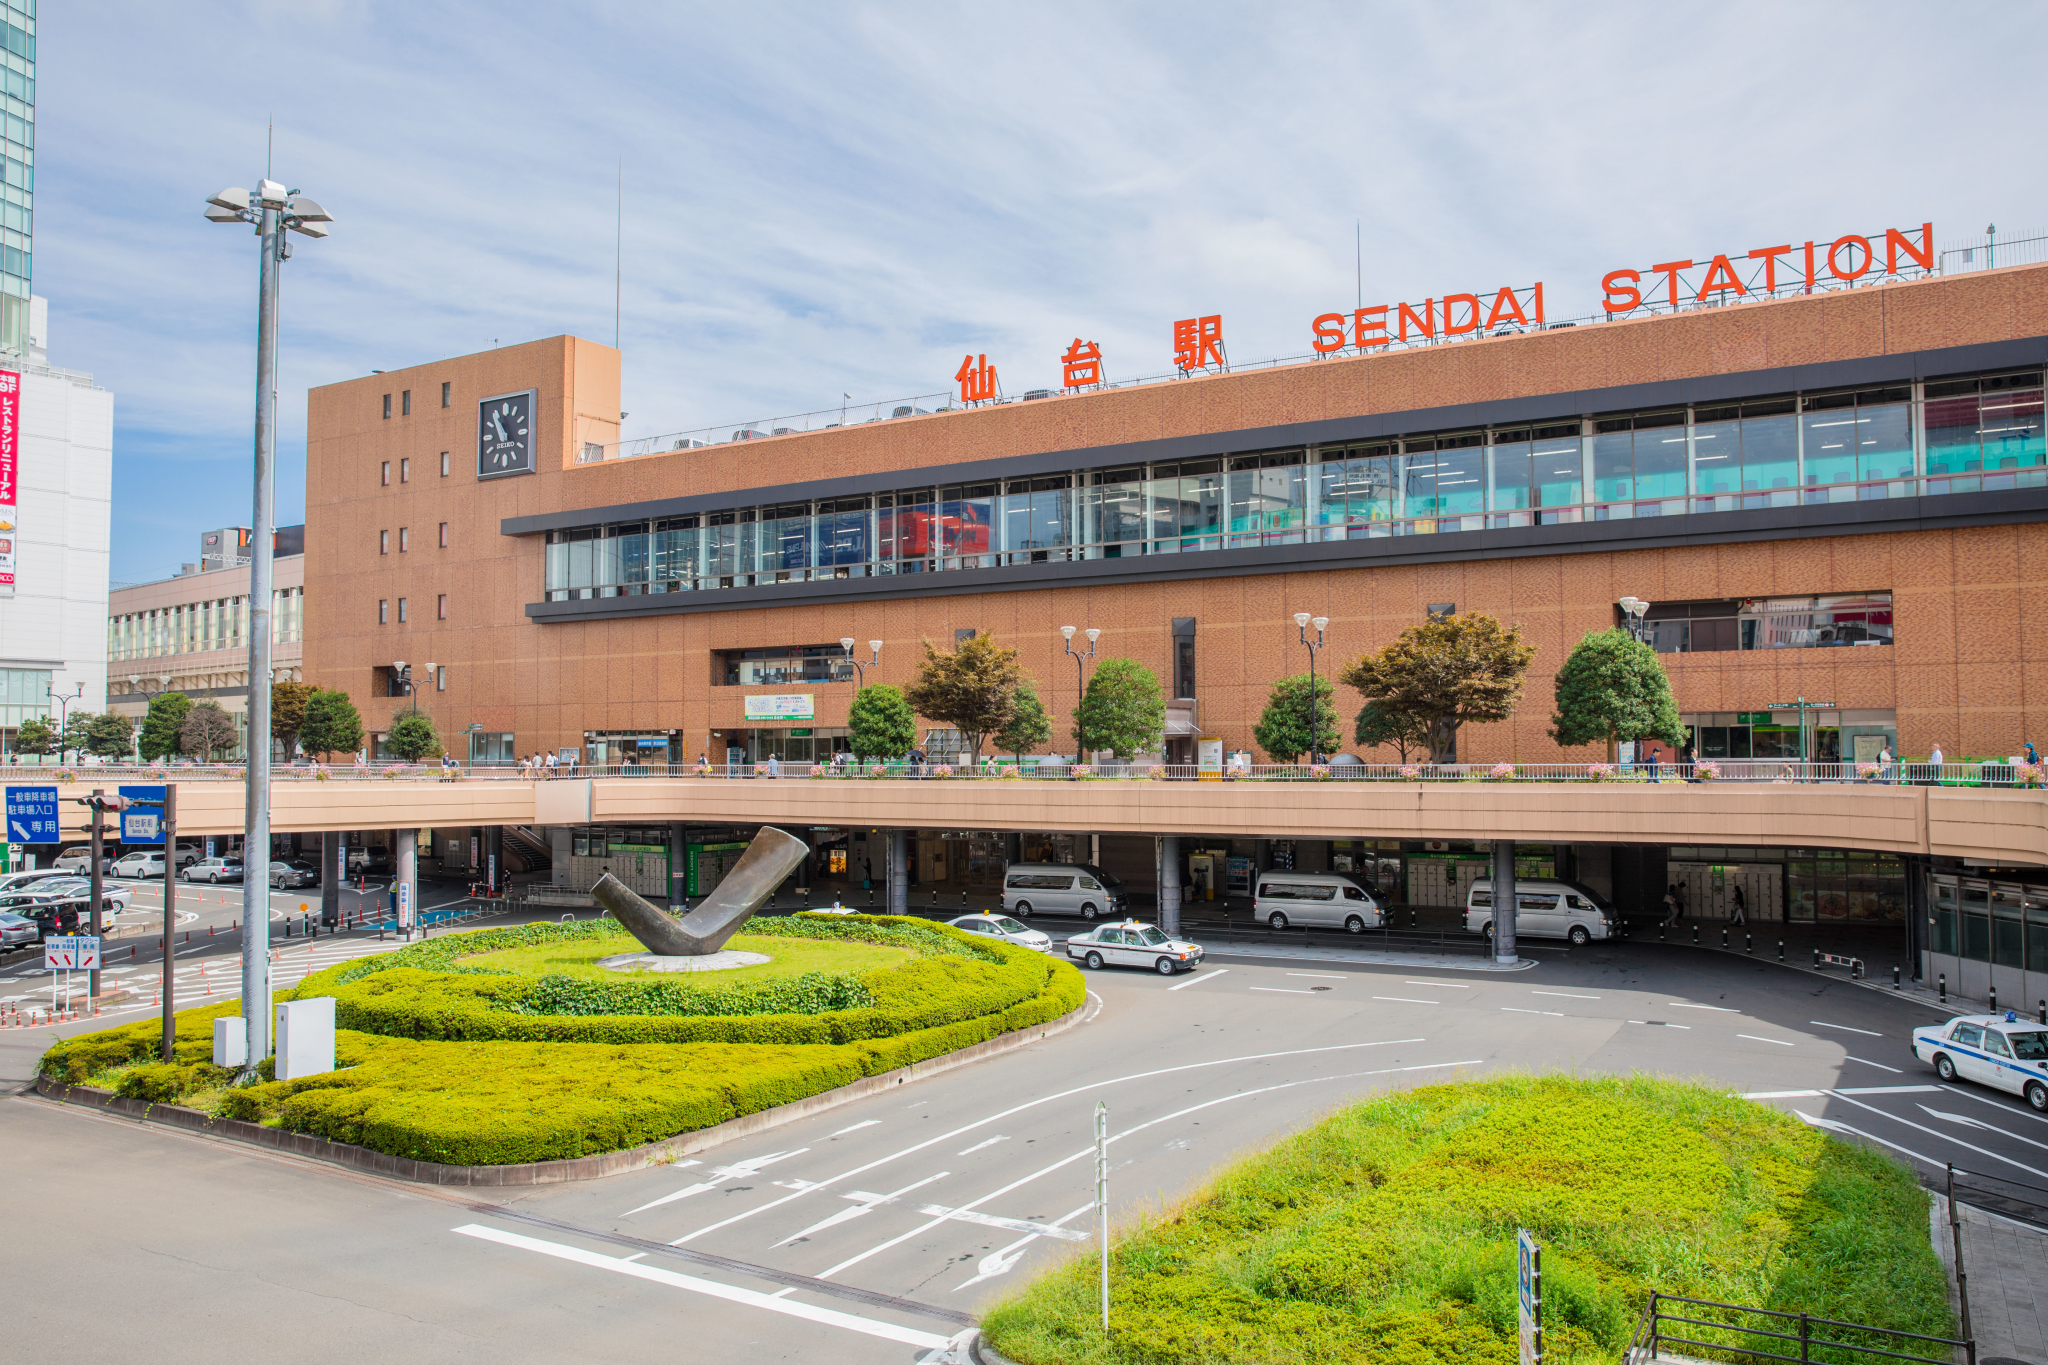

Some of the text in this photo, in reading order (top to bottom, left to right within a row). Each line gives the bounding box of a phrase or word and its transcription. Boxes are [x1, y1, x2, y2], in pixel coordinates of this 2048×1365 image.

[1312, 222, 1932, 353] SENDAI STATION
[954, 314, 1224, 403] 仙台駅
[0, 382, 17, 394] 9F
[0, 396, 13, 500] レストランリニューアル
[496, 441, 515, 449] SEIKO
[8, 792, 56, 802] 一般車降車場
[8, 805, 53, 815] 駐車場入口
[31, 821, 56, 833] 専用
